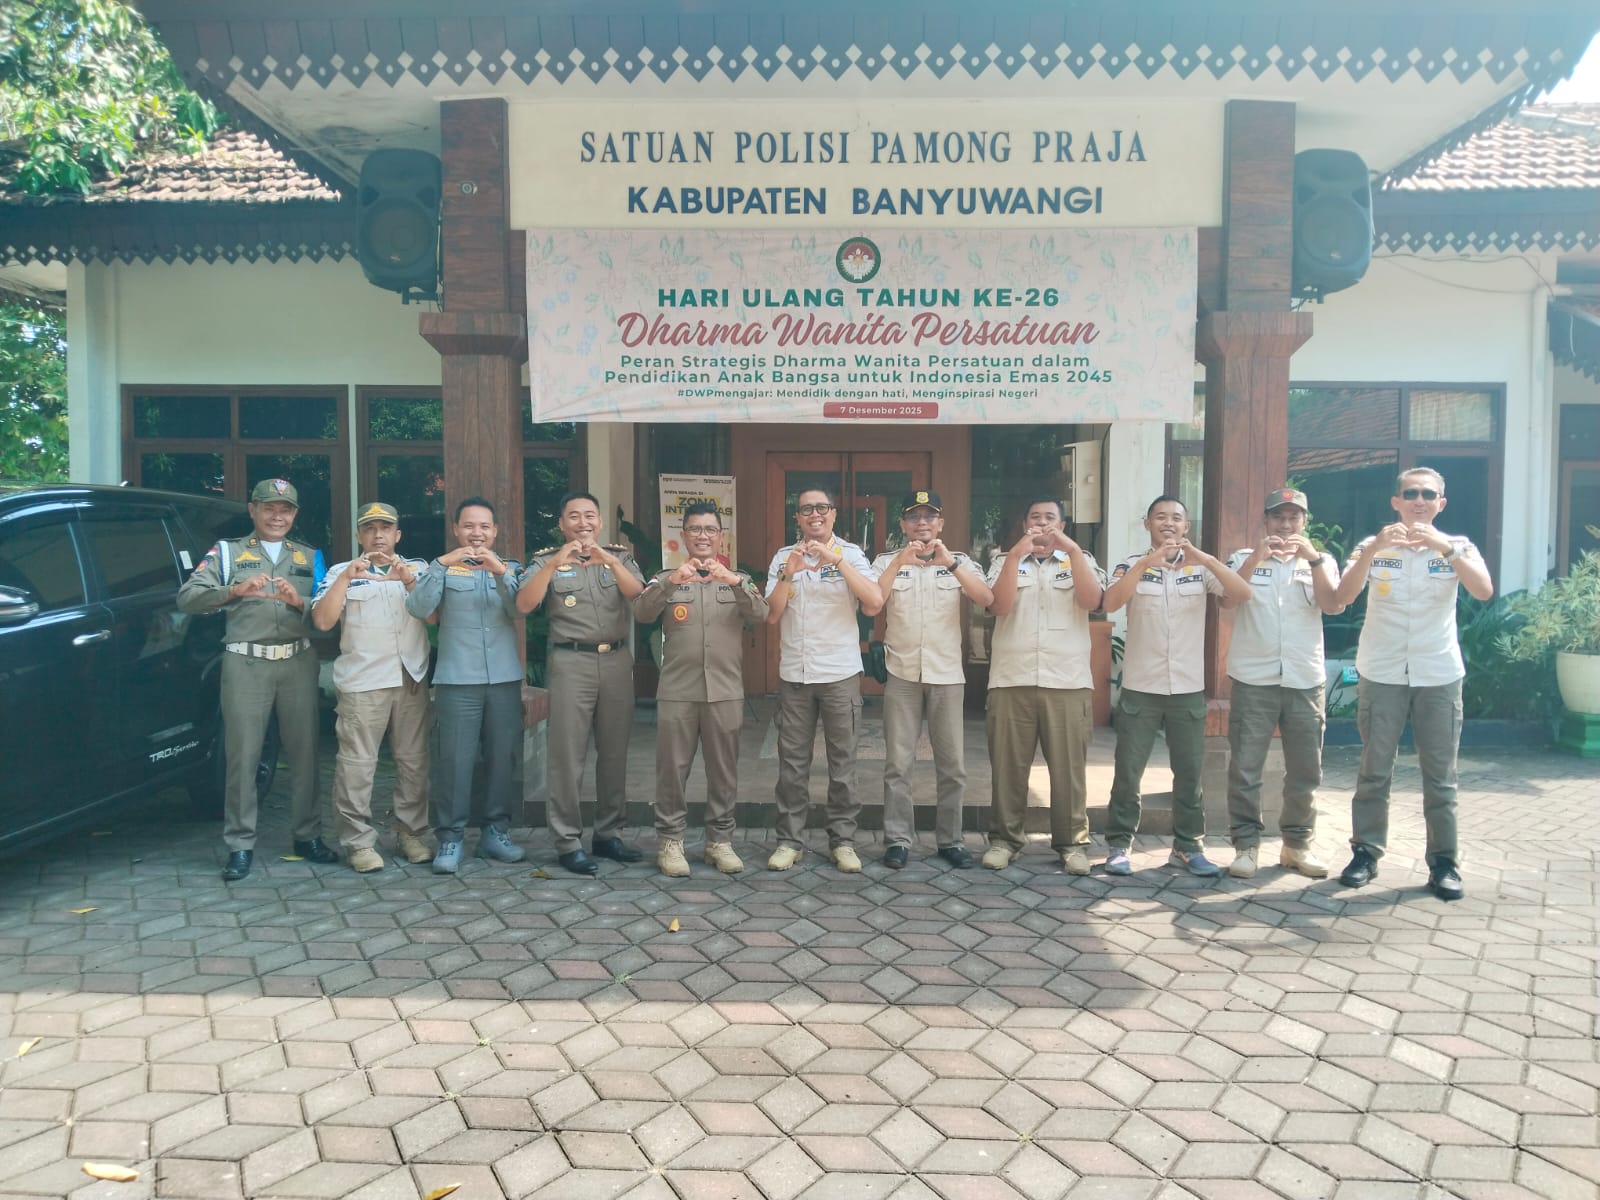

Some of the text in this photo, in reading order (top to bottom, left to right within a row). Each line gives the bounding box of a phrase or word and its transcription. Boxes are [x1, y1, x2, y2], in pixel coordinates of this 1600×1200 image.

[581, 131, 1147, 163] SATUAN POLISI PAMONG PRAJA
[628, 187, 1102, 215] KABUPATEN BANYUWANGI
[659, 288, 1058, 307] HARI ULANG TAHUN KE-26
[616, 312, 1100, 347] Dharma Wanita Persatuan
[622, 354, 1089, 371] Peran Strategis Dharma Wanita Persatuan dalam
[606, 370, 1111, 385] Pendidikan Anak Bangsa untuk Indonesia Emas 2045
[678, 389, 1037, 401] #DWPmengajar: Mendidik dengan hati, Menginspirasi Negeri
[839, 406, 922, 414] 7 Desember 2025
[678, 496, 717, 507] ZONA
[149, 747, 173, 763] TRD
